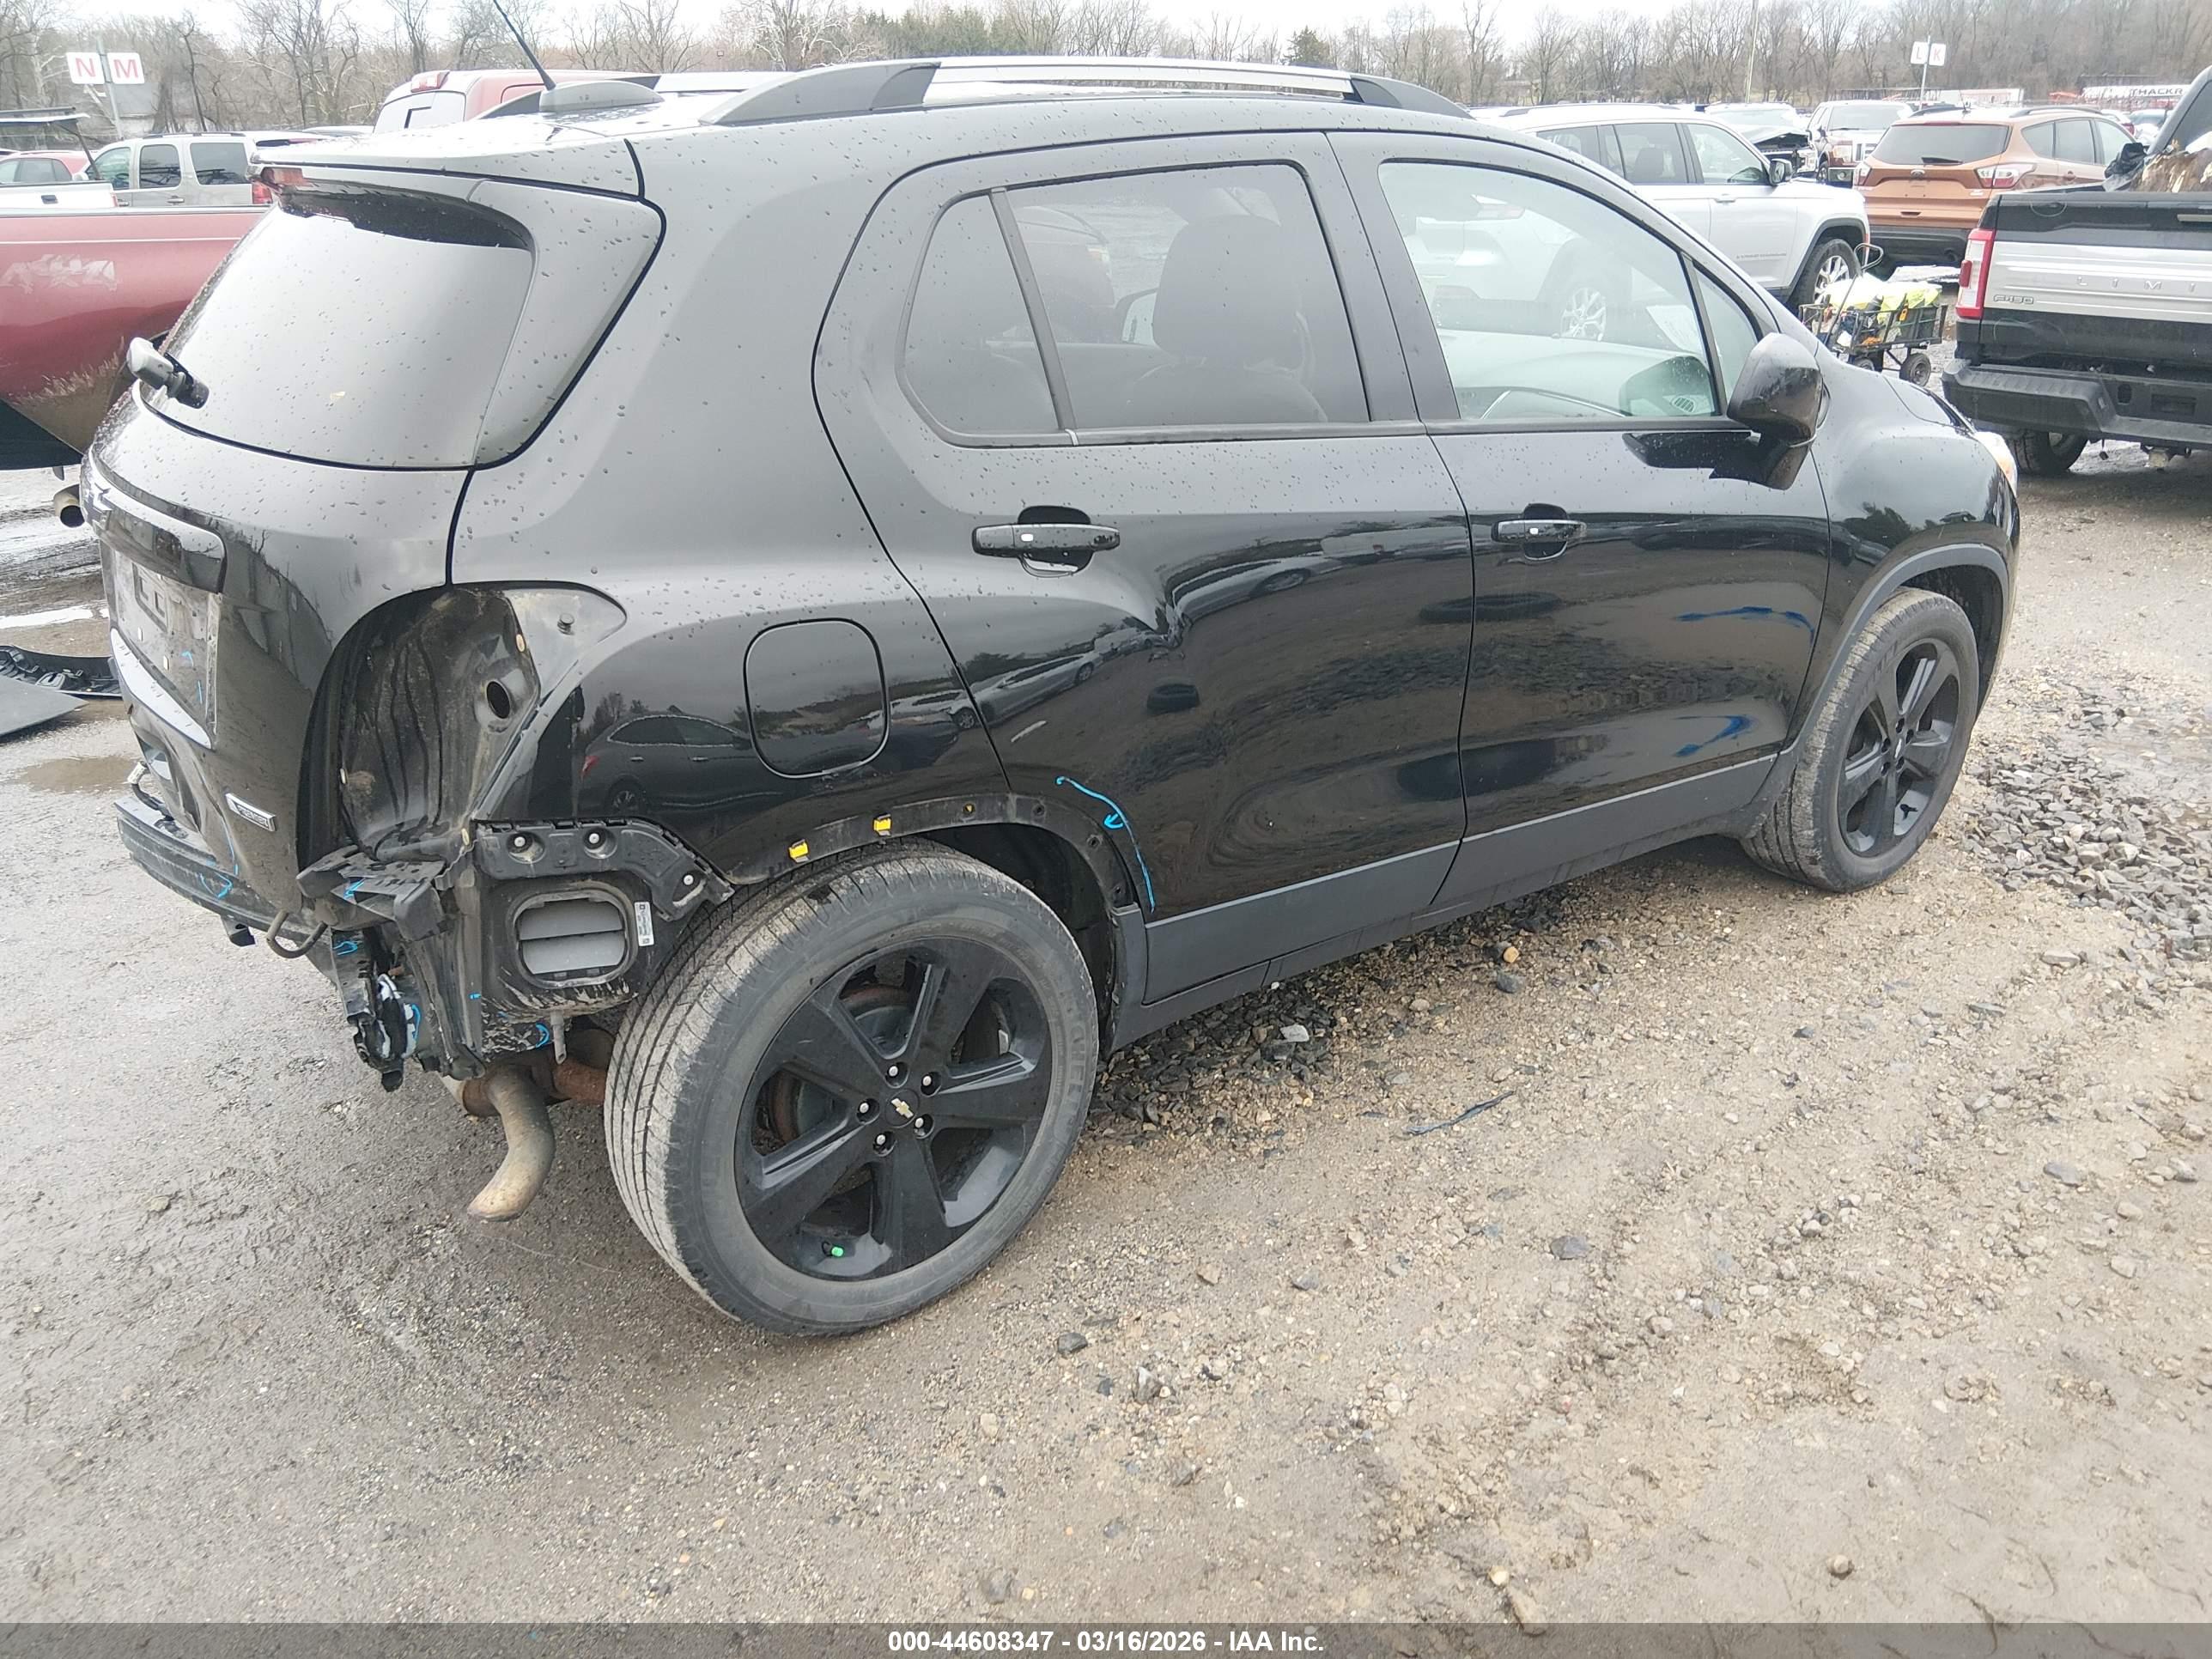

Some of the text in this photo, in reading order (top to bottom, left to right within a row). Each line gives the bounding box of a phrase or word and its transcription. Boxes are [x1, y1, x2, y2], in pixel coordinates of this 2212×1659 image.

[1933, 48, 1942, 61] K
[75, 58, 96, 77] N
[113, 59, 139, 78] M
